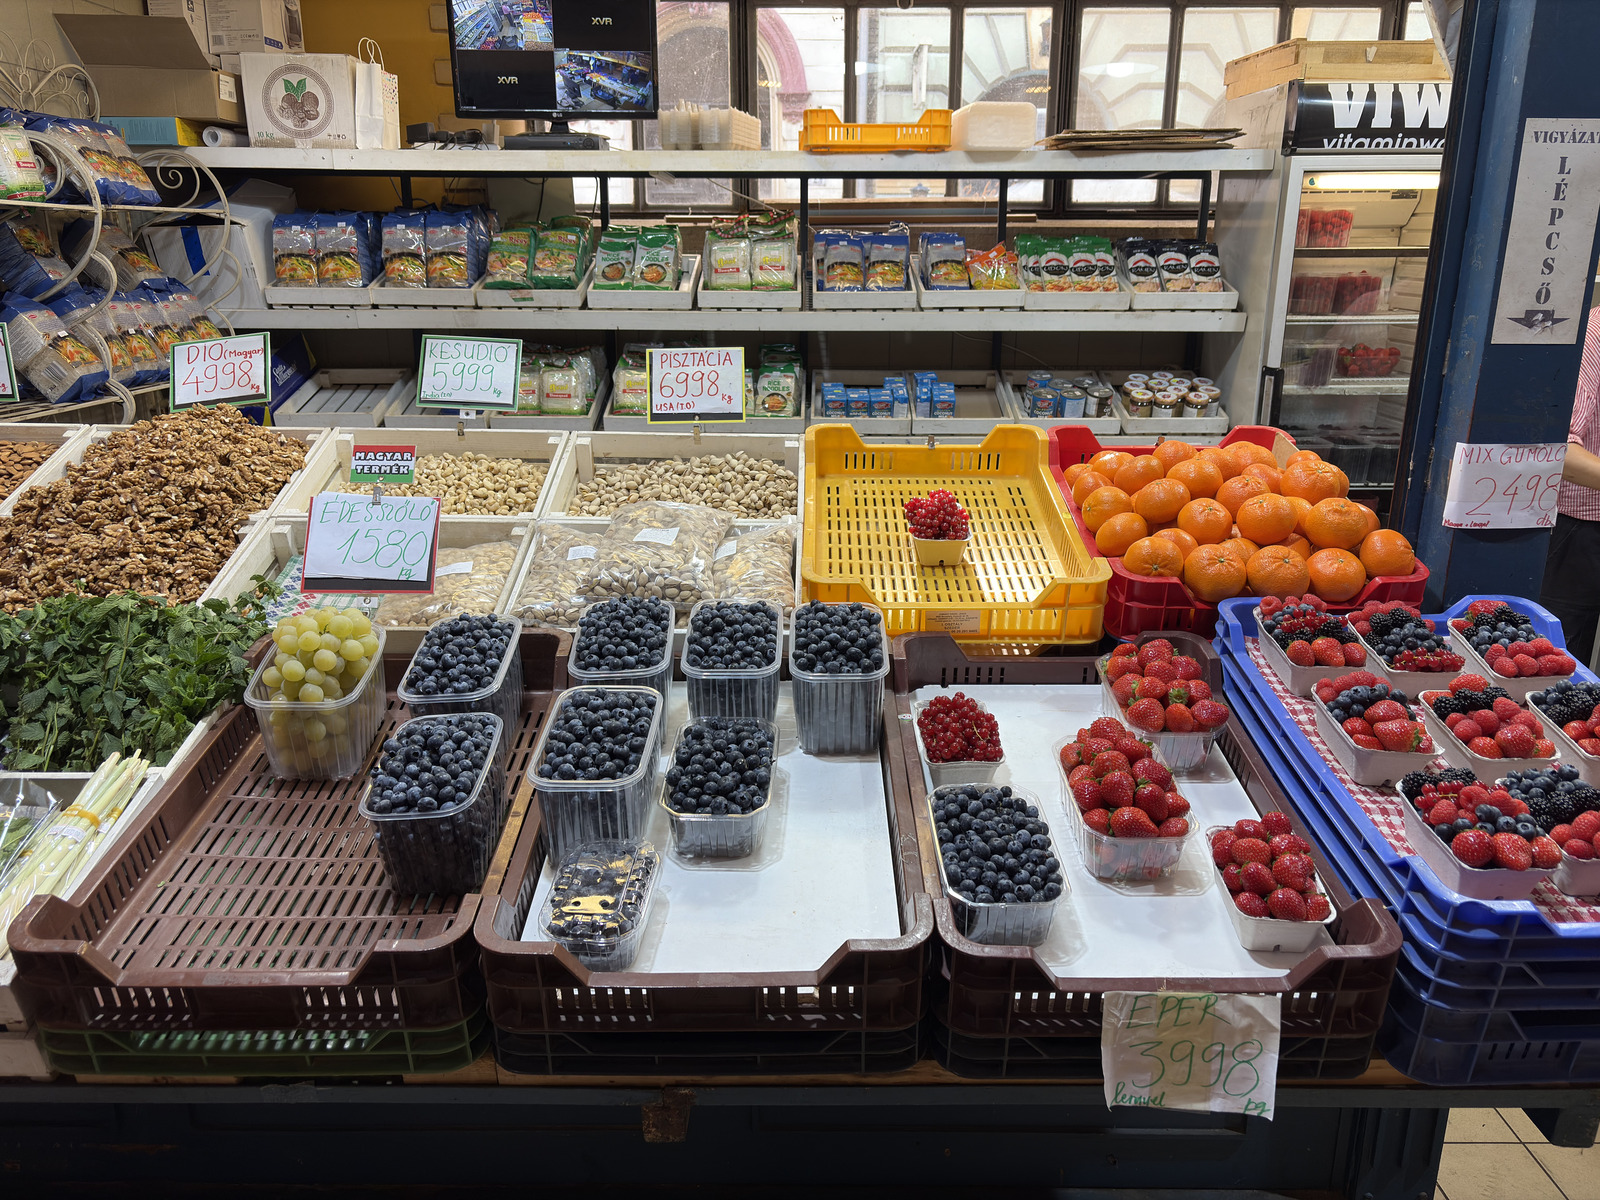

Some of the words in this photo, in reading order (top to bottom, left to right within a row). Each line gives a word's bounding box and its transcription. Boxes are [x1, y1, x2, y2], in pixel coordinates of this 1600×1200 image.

[591, 17, 613, 26] XVR
[497, 76, 519, 85] XVR
[257, 131, 265, 139] 10
[265, 131, 275, 140] kg
[1535, 156, 1572, 305] LÉPCSŐ
[187, 340, 228, 365] DIÓ
[428, 342, 511, 363] KESUDIÓ
[181, 360, 254, 396] 4998
[432, 361, 495, 392] 5999
[659, 369, 720, 399] 6998
[655, 402, 675, 412] USA
[354, 451, 413, 461] MAGYAR
[1459, 446, 1494, 465] MIX
[355, 463, 410, 475] TERMÉK
[1465, 472, 1562, 516] 2498
[337, 528, 428, 569] 1580
[1126, 993, 1232, 1029] EPER
[1129, 1039, 1263, 1099] 3998
